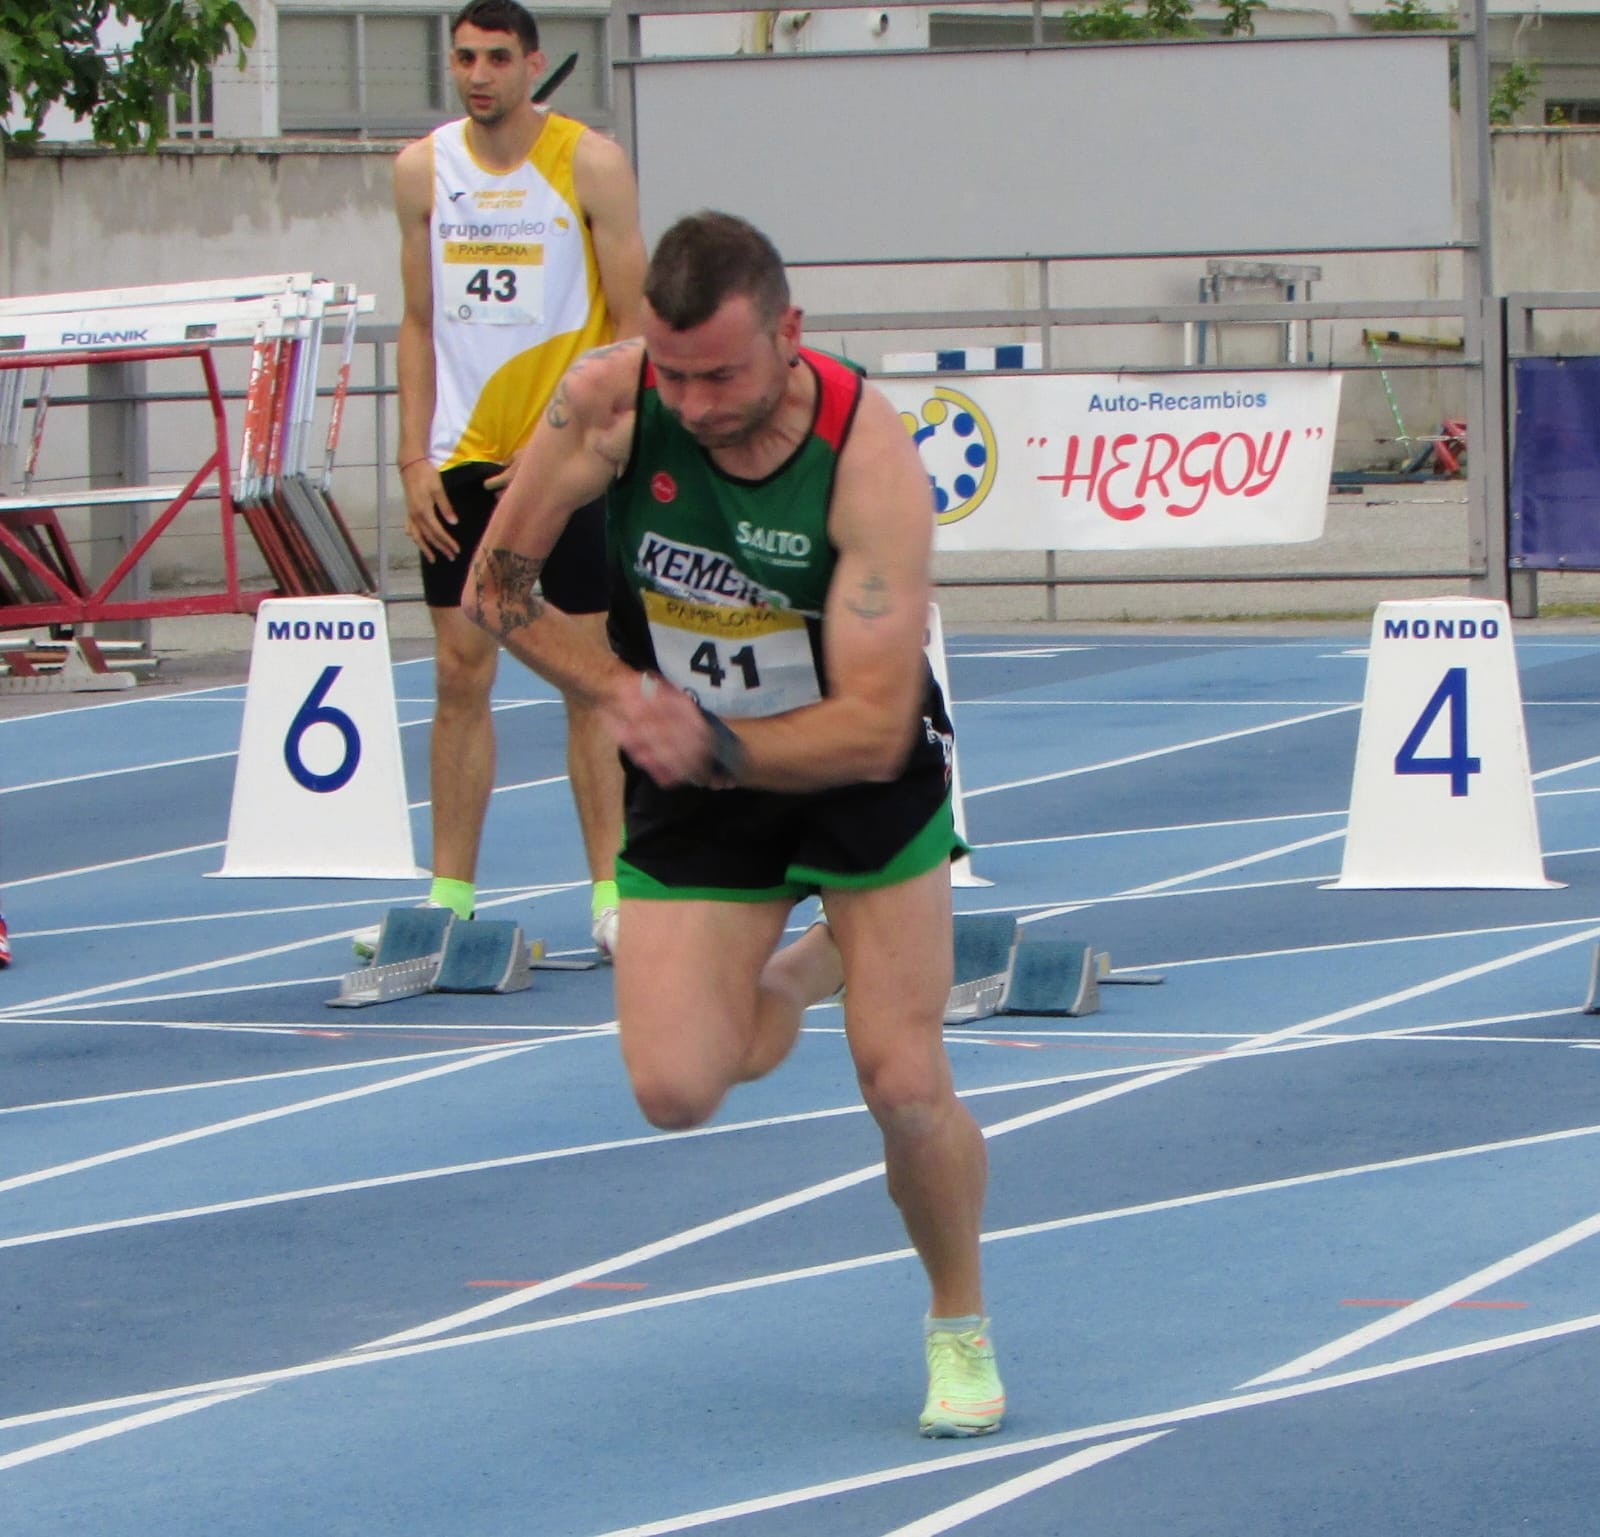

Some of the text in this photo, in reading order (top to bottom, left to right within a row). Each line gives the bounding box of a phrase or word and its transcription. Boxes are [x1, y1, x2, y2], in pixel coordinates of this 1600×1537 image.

[439, 220, 545, 240] grupompleo
[459, 244, 528, 256] PAMPLONA
[466, 269, 518, 302] 43
[61, 328, 149, 346] POLANIK
[1088, 391, 1267, 413] Auto-Recambios
[736, 521, 811, 557] SALTO
[667, 600, 777, 627] PAMPLONA
[267, 620, 376, 641] MONDO
[1384, 618, 1500, 640] MONDO
[689, 639, 761, 690] 41
[284, 665, 362, 794] 6
[1394, 667, 1481, 797] 4
